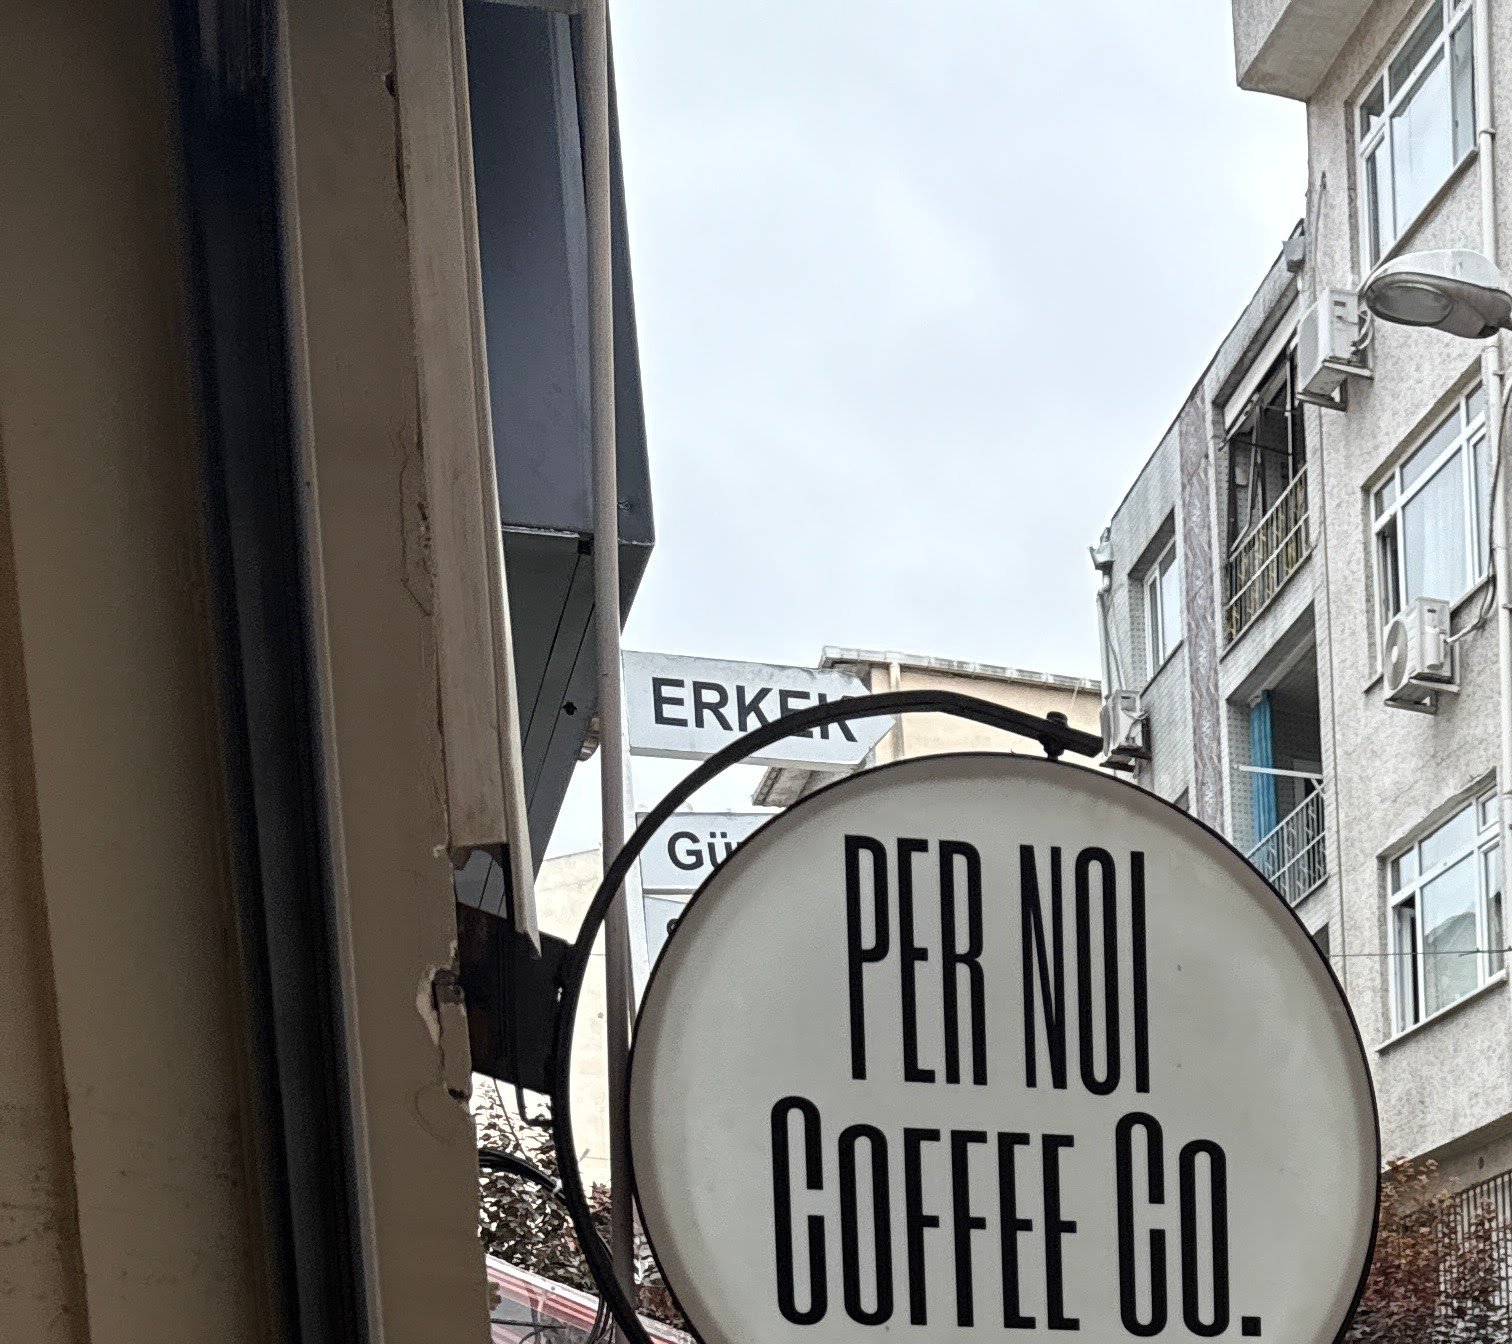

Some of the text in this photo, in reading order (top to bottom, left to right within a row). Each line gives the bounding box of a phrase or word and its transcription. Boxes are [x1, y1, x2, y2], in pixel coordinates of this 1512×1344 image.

[651, 676, 858, 743] ERKEK
[667, 830, 743, 871] Gü
[844, 834, 1151, 1096] PER NOI
[771, 1095, 1263, 1338] COFFEE CO.
